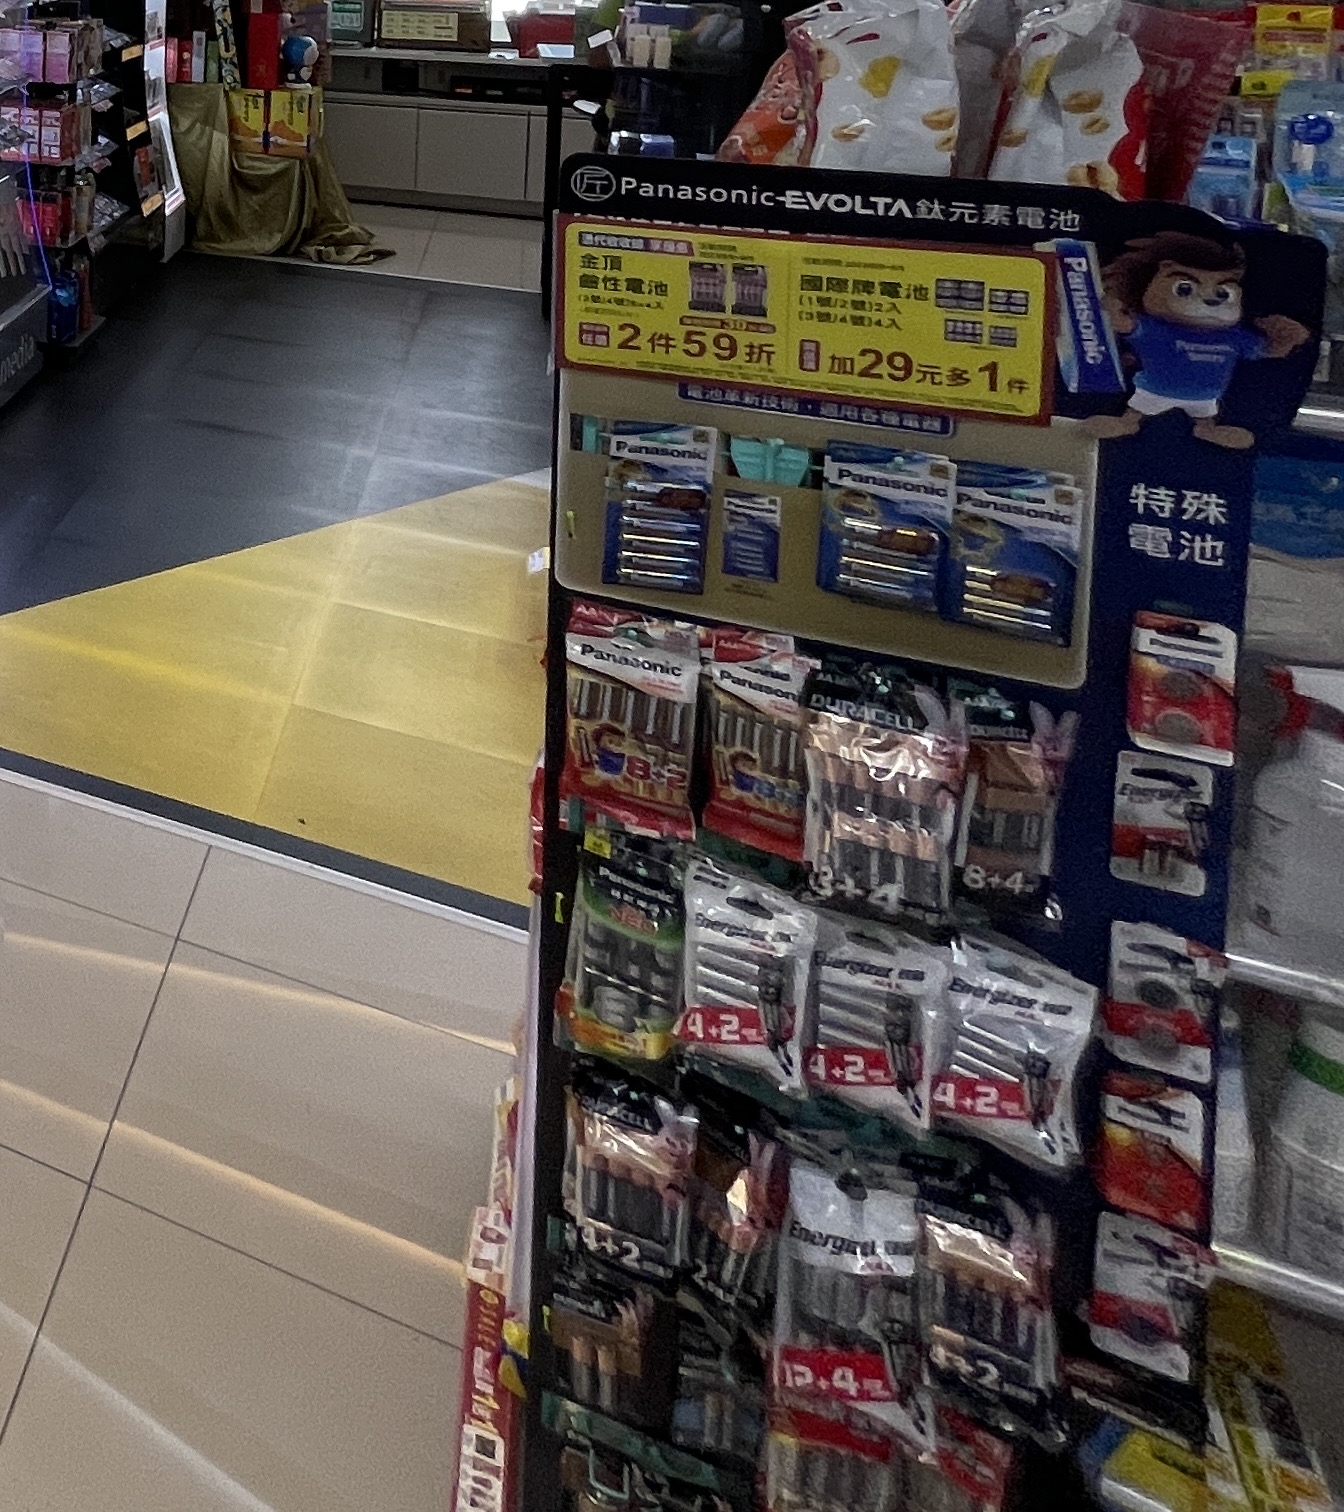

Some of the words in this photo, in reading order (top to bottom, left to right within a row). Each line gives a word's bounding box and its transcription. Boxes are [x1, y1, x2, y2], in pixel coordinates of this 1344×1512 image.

[915, 198, 1081, 232] 鈦元素電池
[580, 253, 623, 272] 金頂
[799, 274, 930, 302] 國際牌電池
[1064, 256, 1108, 366] Panasonic
[617, 322, 777, 366] 2件59折
[616, 440, 707, 462] Panasonic
[838, 468, 948, 500] Panasonic
[956, 492, 1075, 526] Panasonic
[1127, 482, 1231, 528] 特殊
[1126, 522, 1228, 571] 電池
[580, 643, 682, 677] Panasonic
